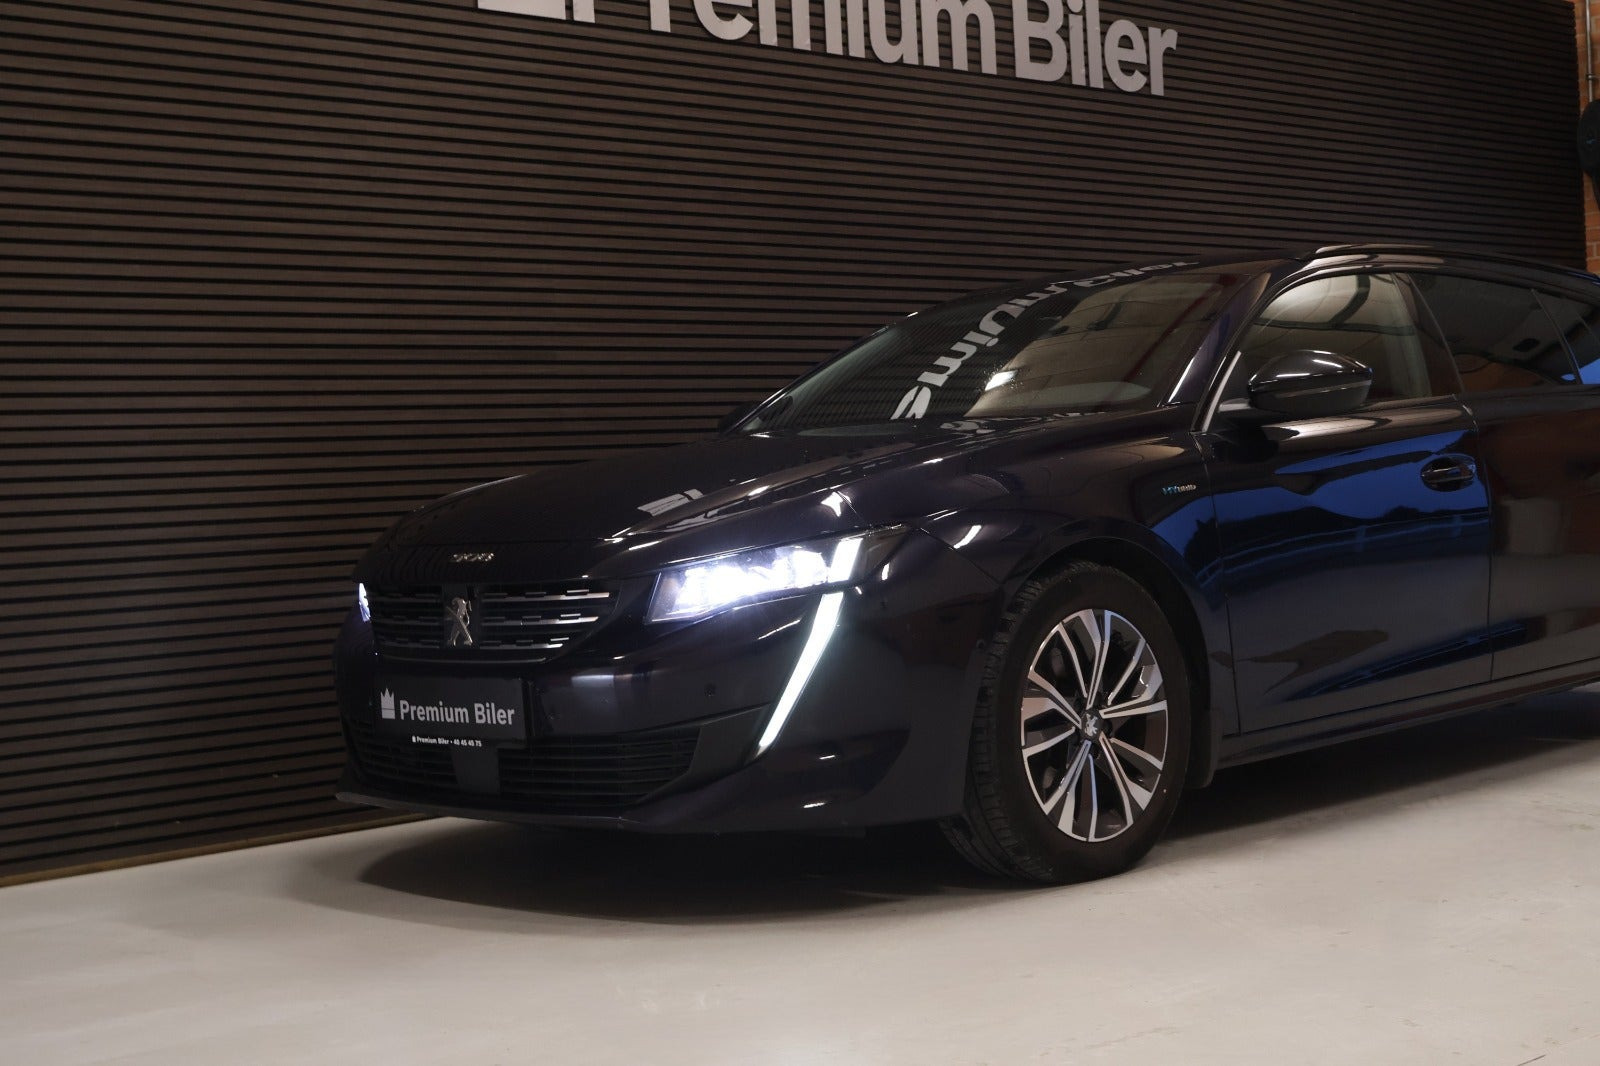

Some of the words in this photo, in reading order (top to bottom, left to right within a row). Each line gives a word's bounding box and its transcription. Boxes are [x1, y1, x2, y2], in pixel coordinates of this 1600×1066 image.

[573, 0, 998, 75] emium
[1012, 0, 1178, 97] Biler
[400, 700, 469, 723] Premium
[474, 703, 515, 725] Biler
[416, 735, 437, 744] Premium
[438, 737, 449, 745] Biler
